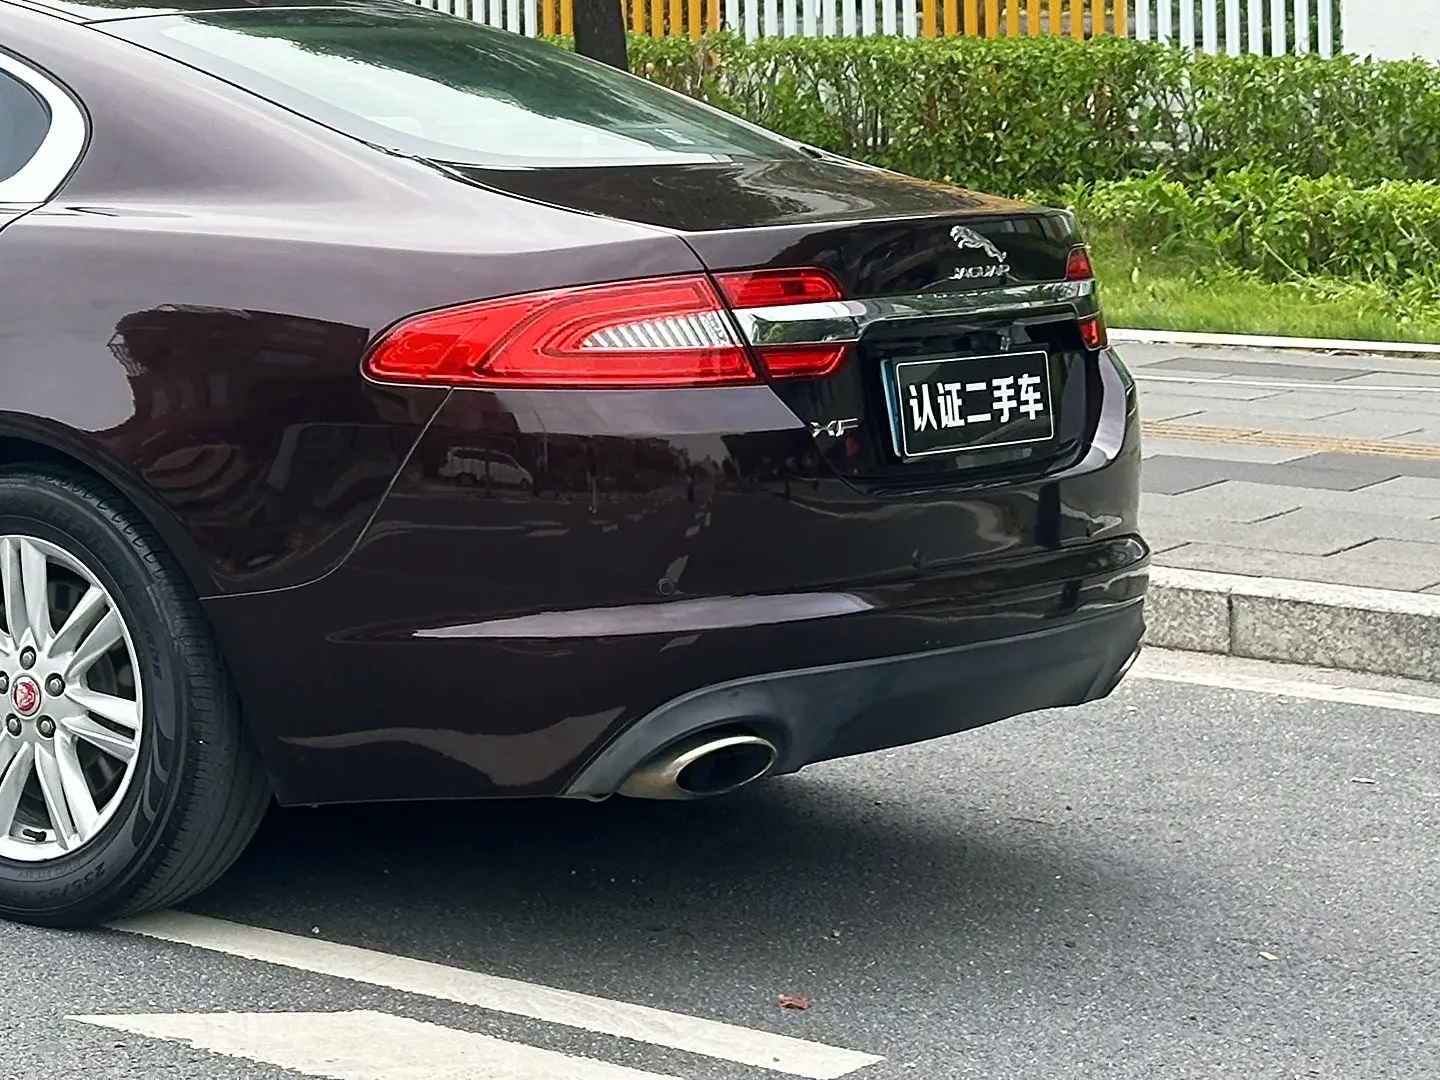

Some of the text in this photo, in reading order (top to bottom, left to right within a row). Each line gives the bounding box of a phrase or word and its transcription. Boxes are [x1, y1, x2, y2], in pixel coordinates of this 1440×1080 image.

[948, 264, 1011, 280] JAGUAR
[908, 374, 1045, 433] 认证二手车
[808, 417, 859, 438] XF
